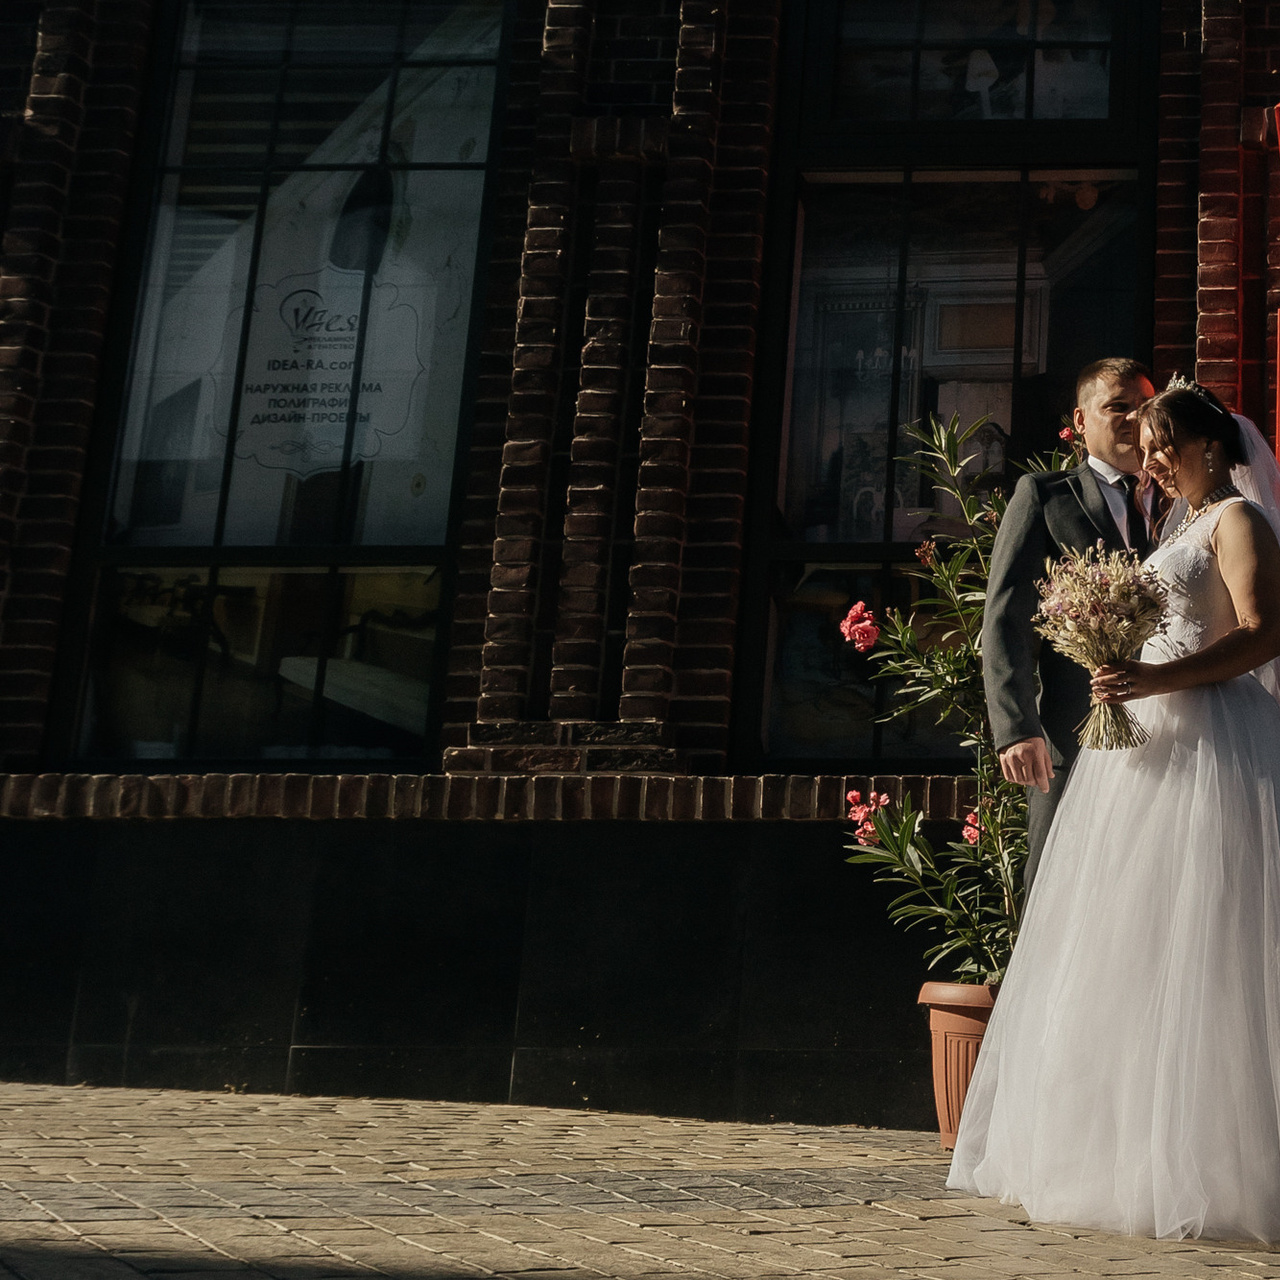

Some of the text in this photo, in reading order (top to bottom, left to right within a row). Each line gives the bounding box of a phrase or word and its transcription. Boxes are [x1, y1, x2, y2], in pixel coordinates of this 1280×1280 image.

[245, 382, 382, 394] НАРУЖНАЯ РЕКЛМА
[268, 398, 353, 408] ПОЛИГРАФИ
